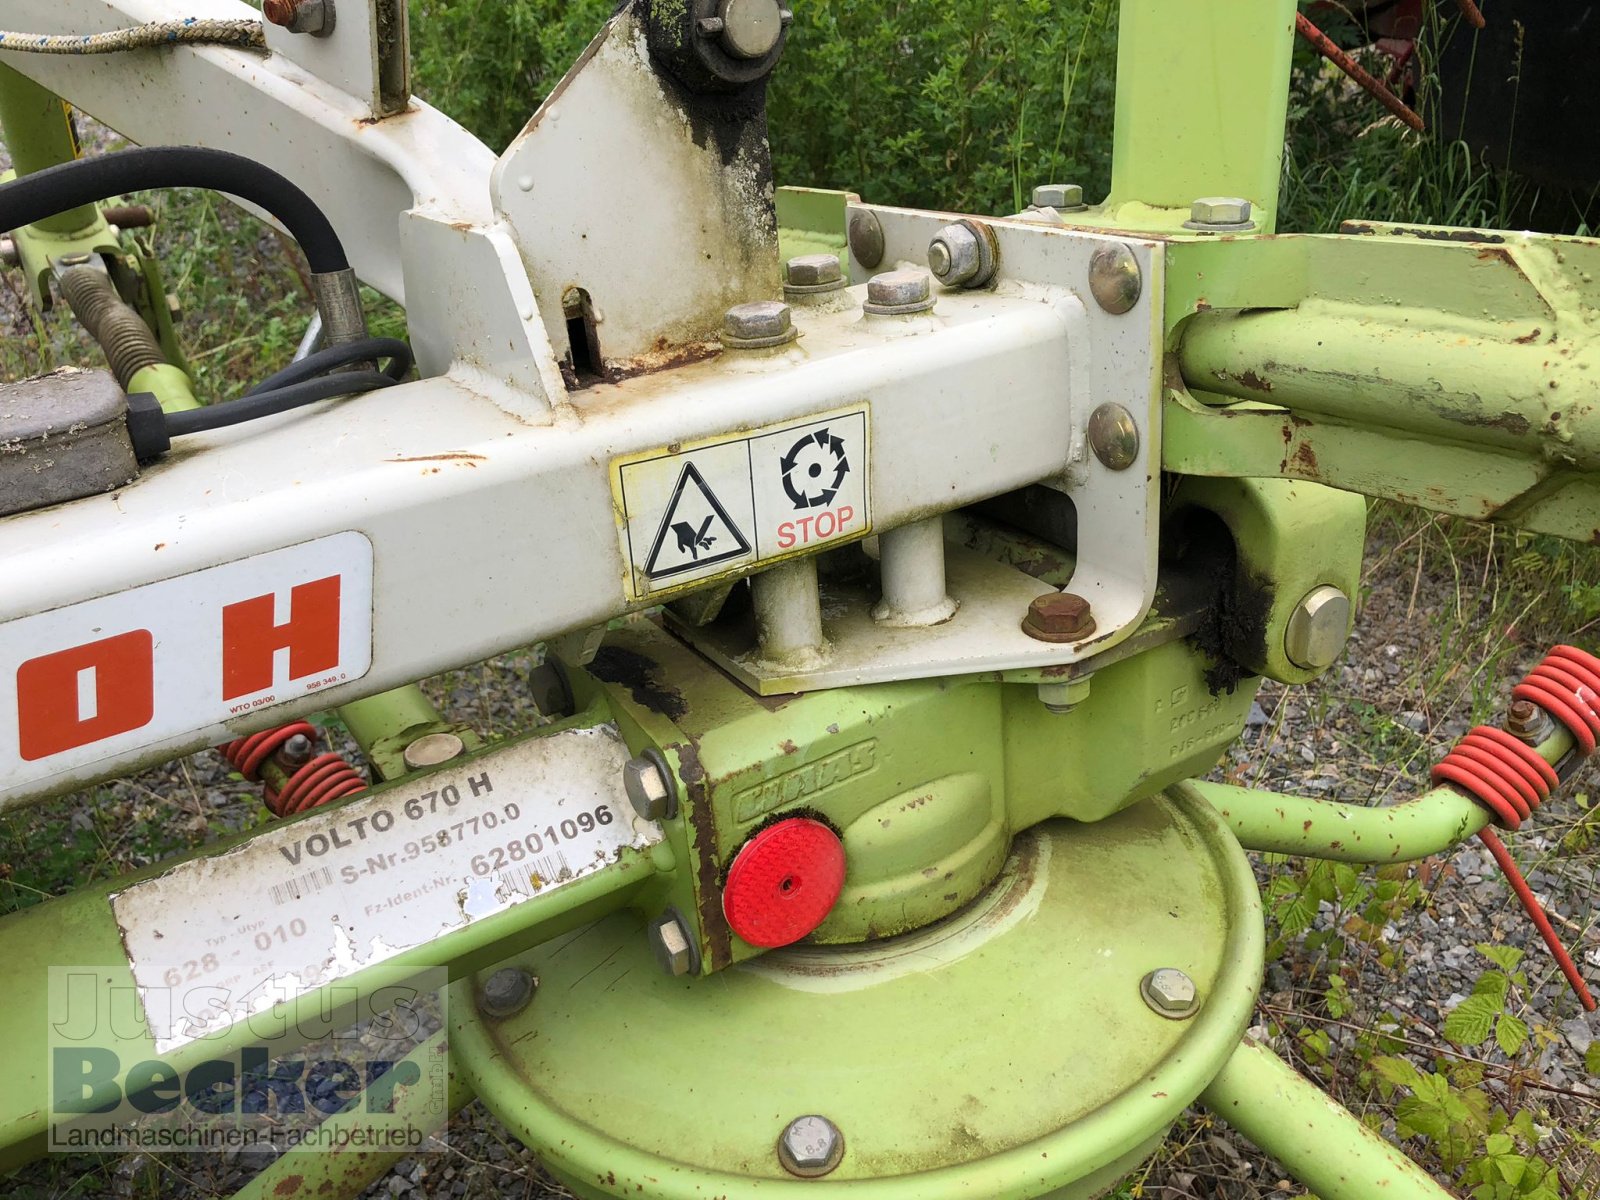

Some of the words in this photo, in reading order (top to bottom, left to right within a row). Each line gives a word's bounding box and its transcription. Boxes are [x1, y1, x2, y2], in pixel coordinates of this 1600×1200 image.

[777, 505, 854, 548] STOP
[229, 703, 251, 714] WTO
[252, 695, 276, 706] 03/00
[279, 808, 396, 866] VOLTO
[403, 784, 461, 821] 670
[467, 771, 494, 797] H
[470, 804, 614, 877] 62801096
[163, 952, 220, 988] 628
[253, 917, 307, 951] 010
